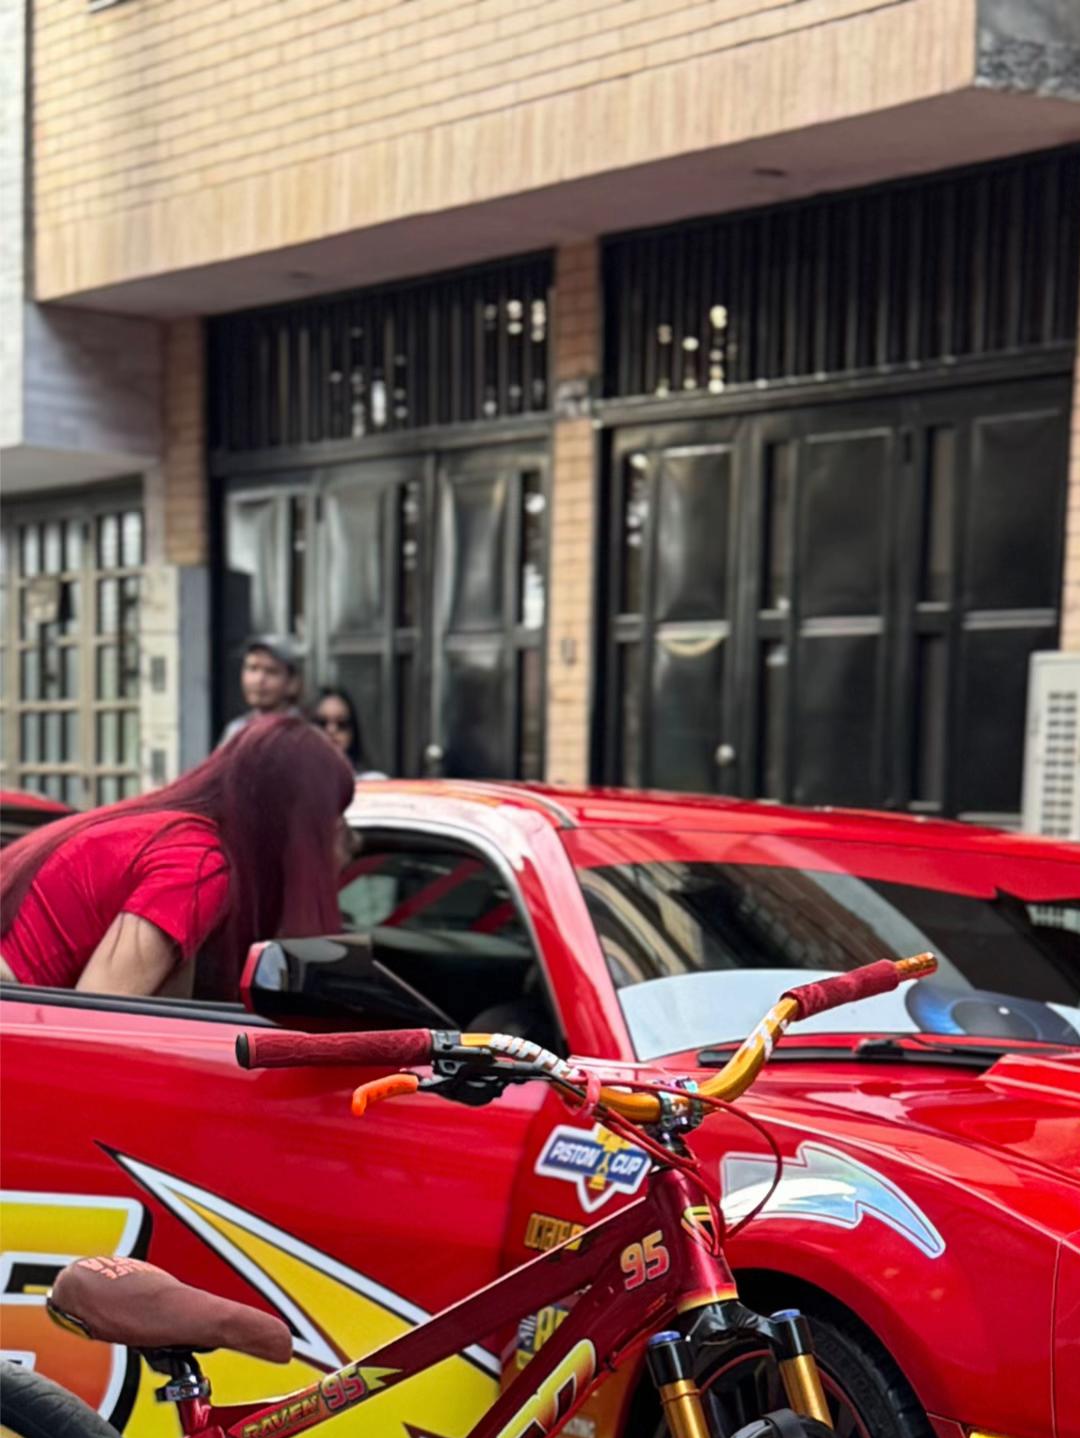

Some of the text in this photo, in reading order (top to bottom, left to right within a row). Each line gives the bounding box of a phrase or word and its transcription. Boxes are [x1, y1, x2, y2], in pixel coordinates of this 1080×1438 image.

[549, 1140, 643, 1176] PISTON CUP
[620, 1229, 671, 1291] 95
[320, 1364, 369, 1413] 95
